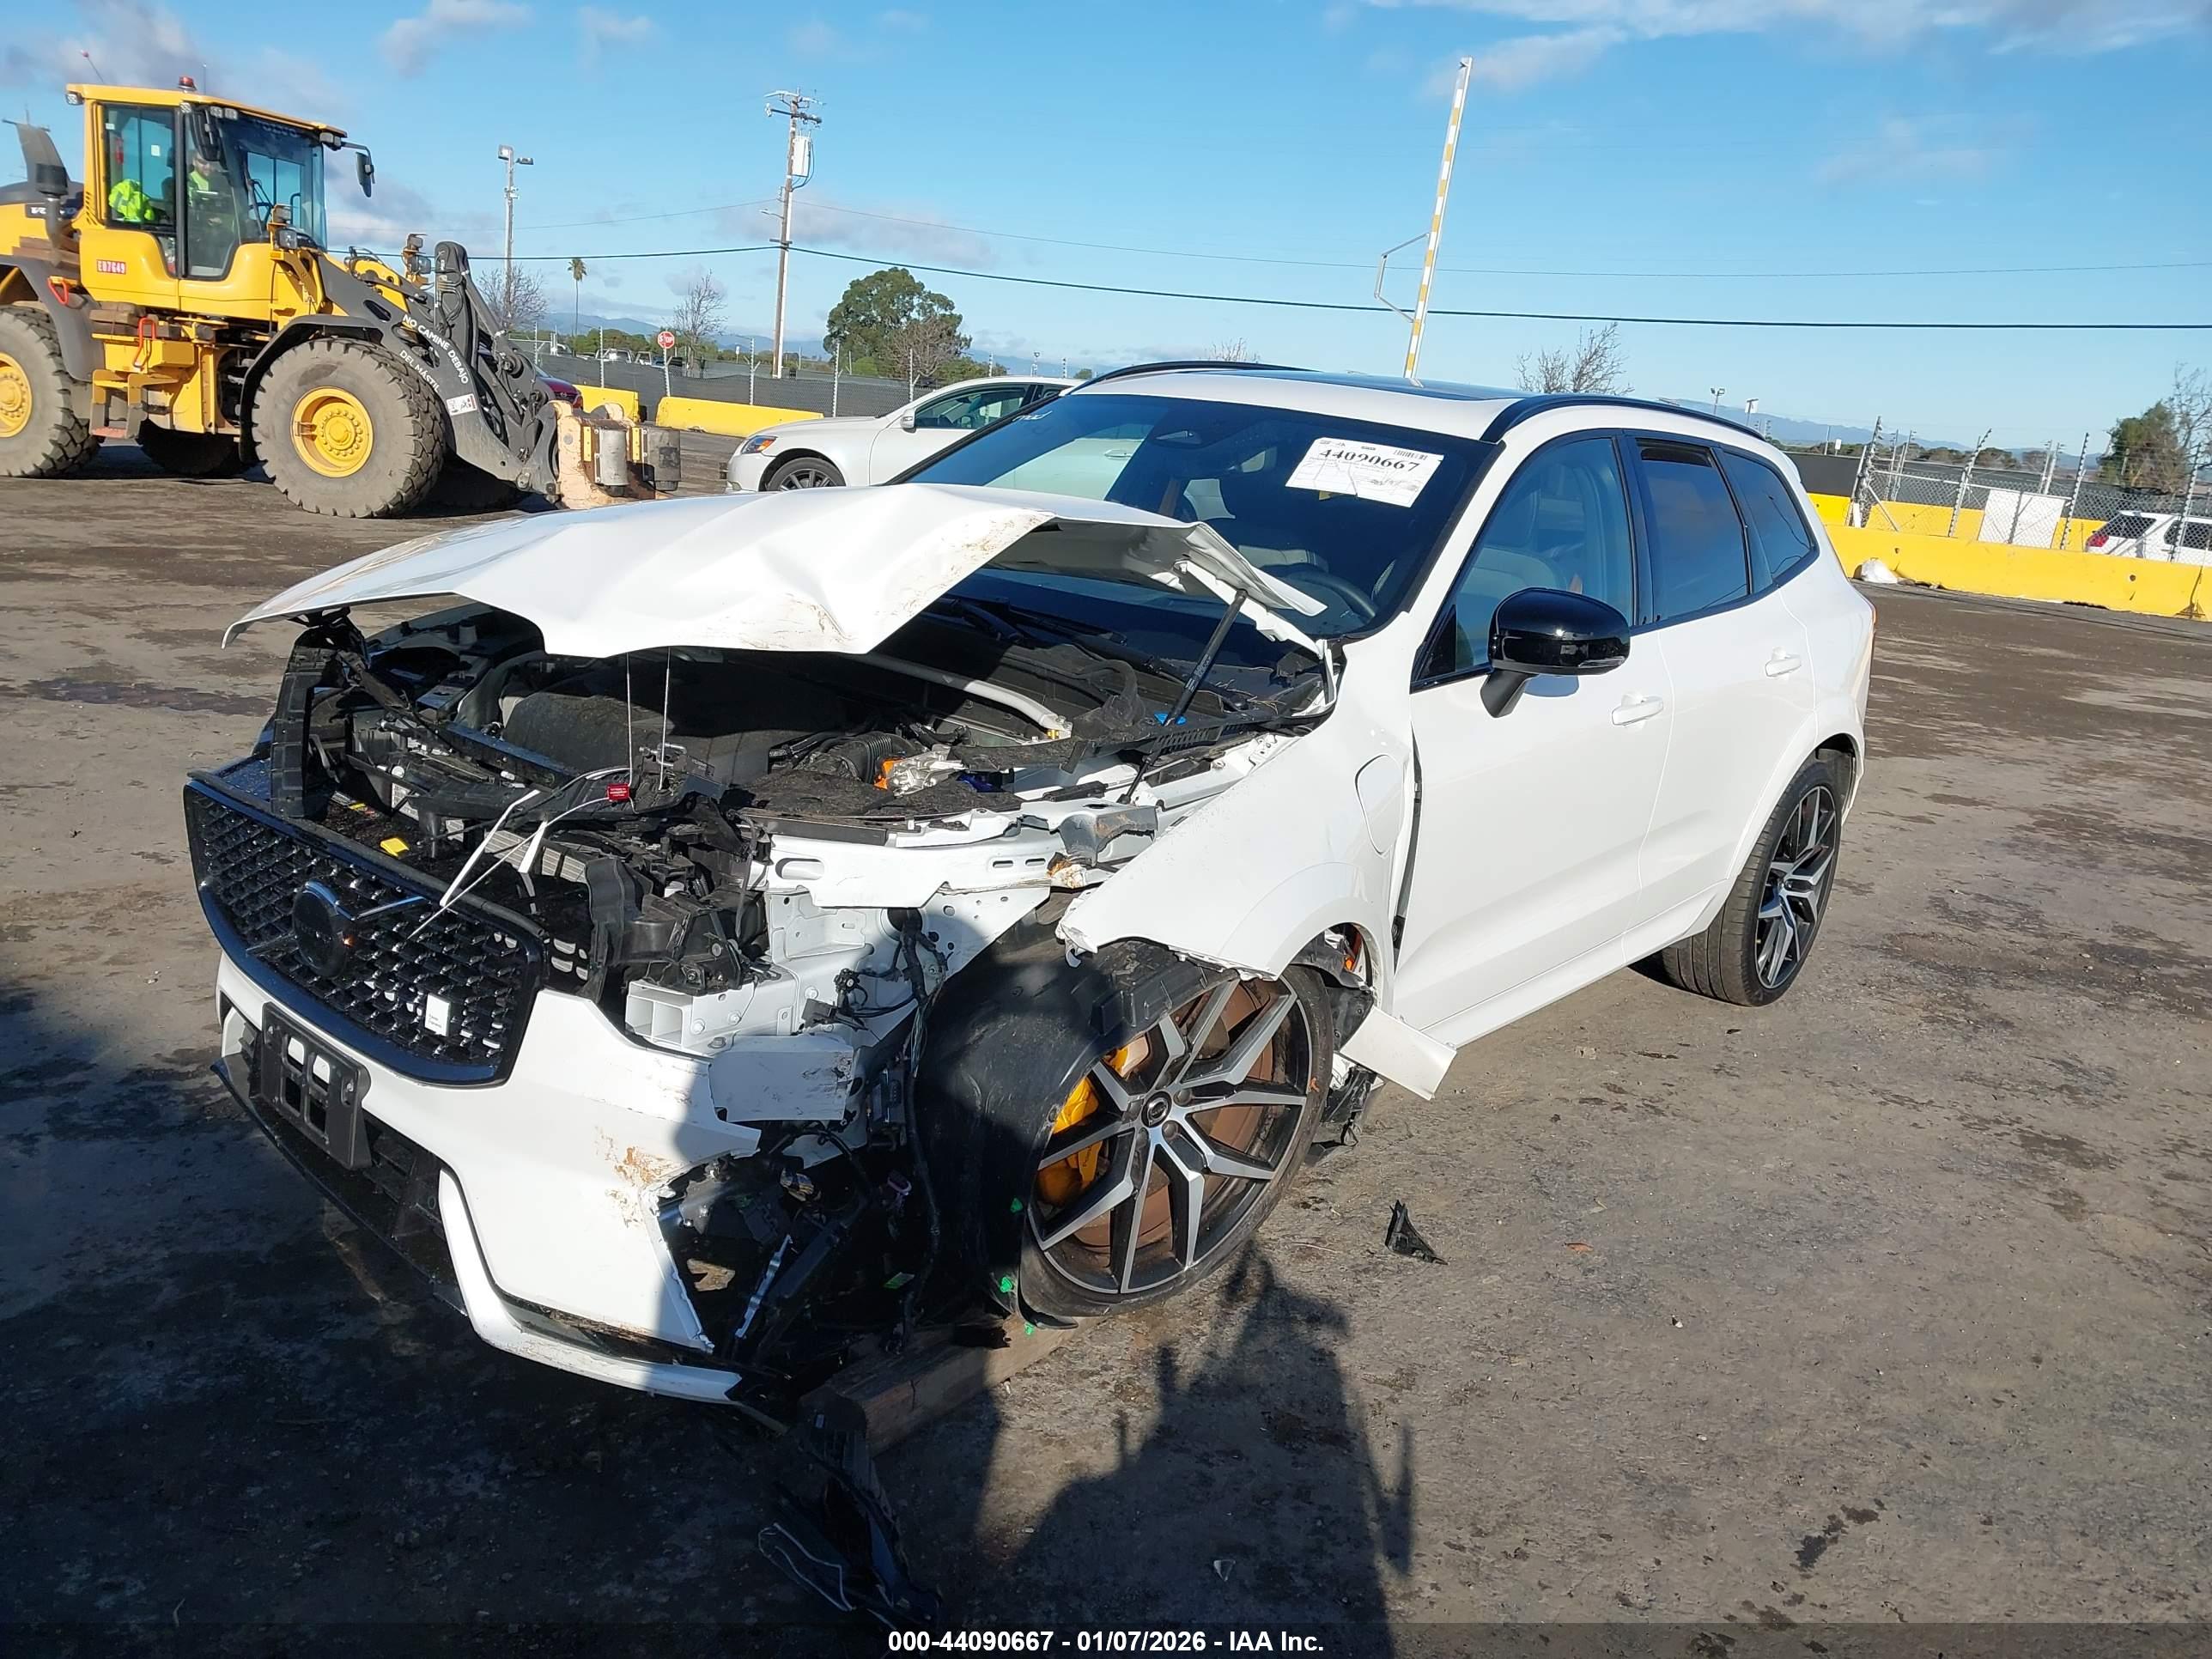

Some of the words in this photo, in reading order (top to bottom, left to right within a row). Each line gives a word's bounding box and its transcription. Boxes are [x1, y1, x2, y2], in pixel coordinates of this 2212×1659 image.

[402, 313, 418, 327] NO
[417, 325, 451, 350] CAMINE
[447, 349, 469, 384] DEBAJO
[399, 349, 415, 367] DEL
[414, 364, 441, 392] MÁSTIL
[1318, 448, 1421, 472] 44090667
